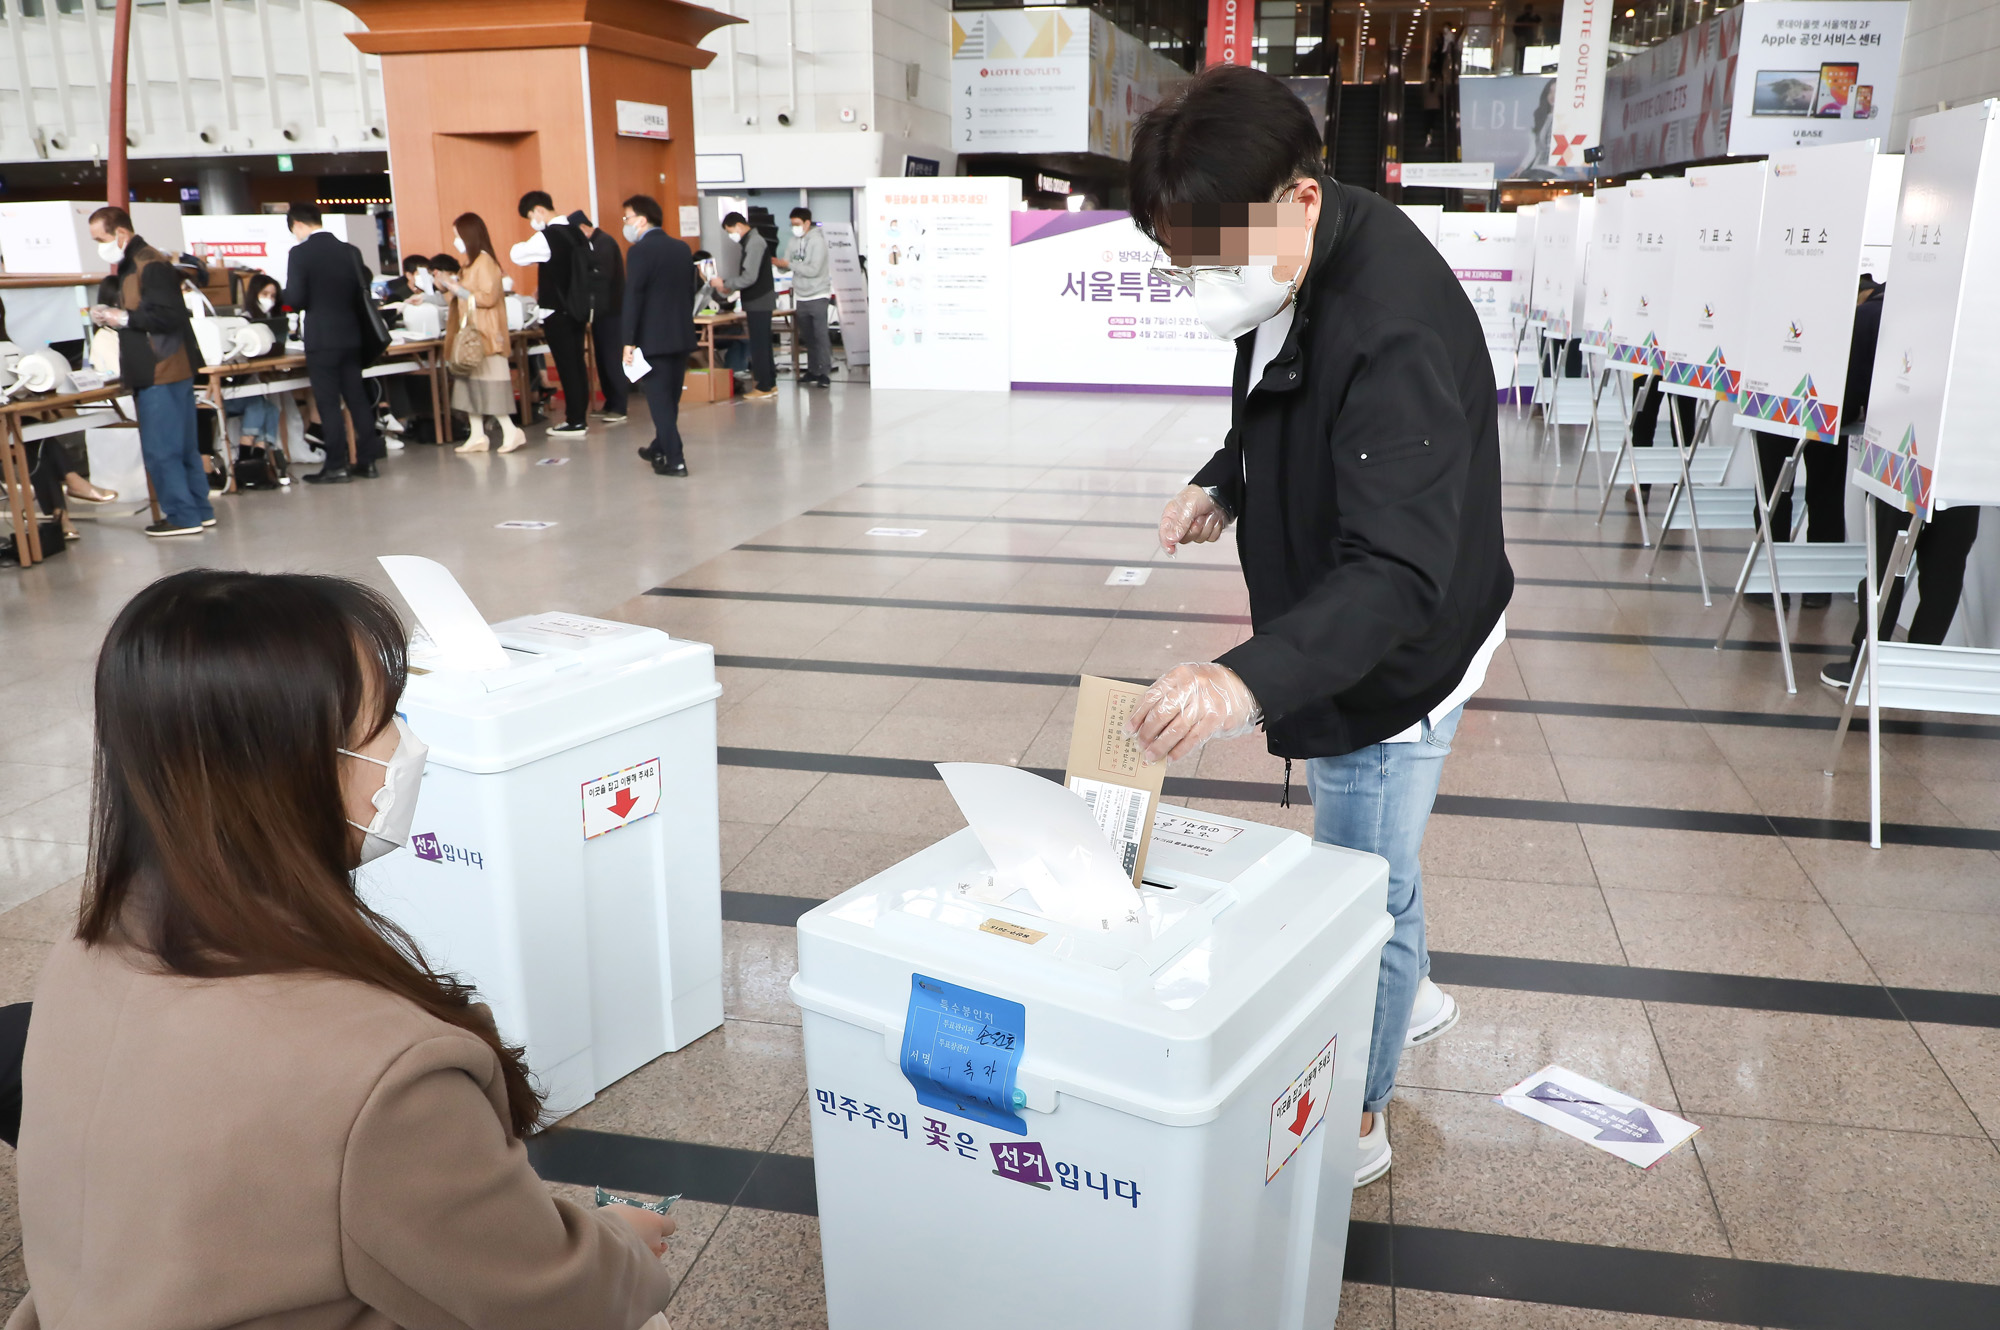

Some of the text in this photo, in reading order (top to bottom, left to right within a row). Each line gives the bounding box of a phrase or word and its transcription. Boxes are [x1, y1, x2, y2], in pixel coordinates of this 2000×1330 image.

[1224, 0, 1237, 44] OTTE
[1822, 20, 1857, 29] 서울역점
[1859, 20, 1871, 29] 2F
[1761, 33, 1881, 46] Apple 공인 서비스 센터
[1573, 0, 1595, 109] OTTE OUTLETS
[1024, 68, 1061, 76] OUTLETS
[965, 86, 972, 96] 4
[1627, 85, 1688, 124] LOTTE OUTLETS
[965, 107, 972, 119] 3
[1471, 101, 1528, 131] LBL
[965, 129, 972, 141] 2
[1793, 130, 1823, 138] U BASE
[1699, 228, 1733, 243] 기표소
[1785, 228, 1828, 245] 기표소
[1139, 317, 1151, 325] 4월
[1153, 317, 1177, 326] 7일(수)
[1179, 317, 1192, 326] 오전
[1139, 331, 1151, 339] 4월
[1184, 331, 1196, 339] 4월
[589, 784, 606, 798] 이곳을
[608, 780, 619, 792] 잡고
[638, 767, 654, 780] 주세요
[939, 998, 993, 1024] 특수봉인지
[942, 1019, 975, 1035] 투표관리관
[910, 1050, 931, 1065] 서명
[1276, 1095, 1291, 1119] 이곳을
[1317, 1050, 1331, 1073] 주세요
[815, 1087, 909, 1139] 민주주의
[922, 1115, 979, 1160] 꽃은
[609, 1195, 628, 1205] PACK
